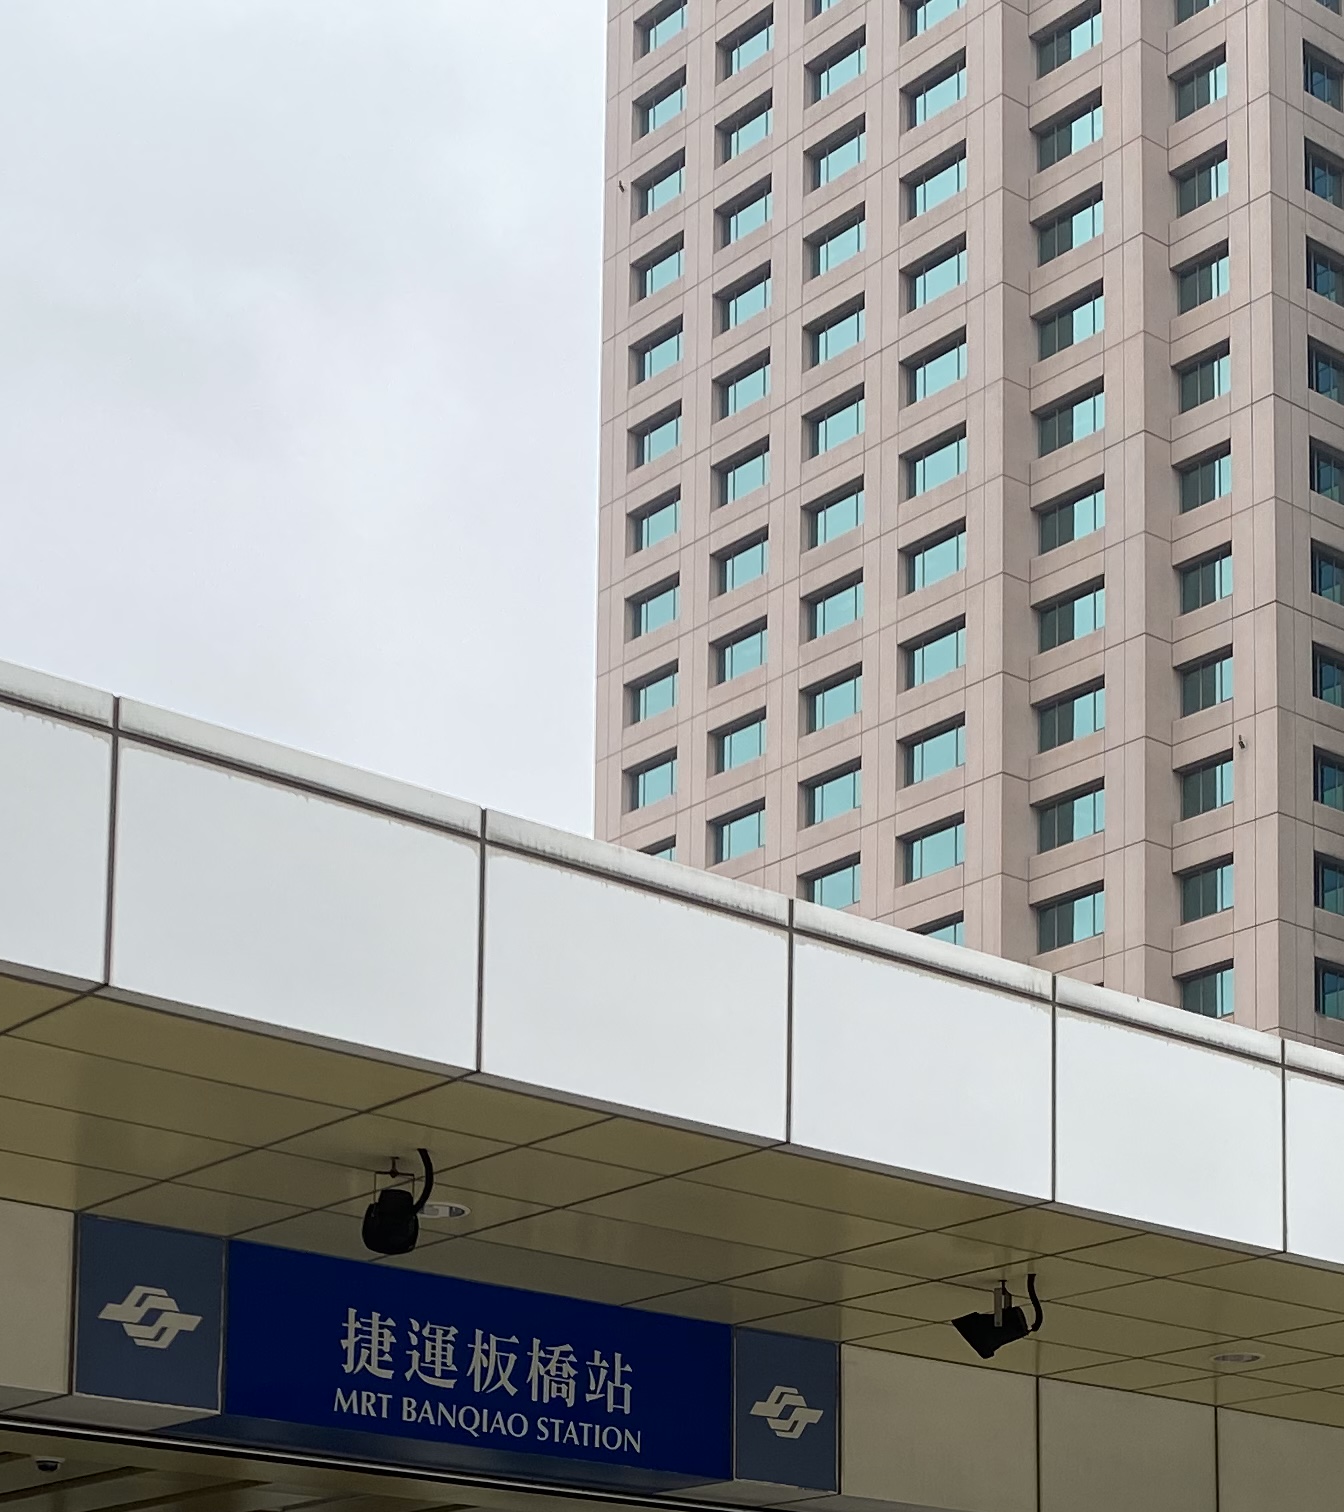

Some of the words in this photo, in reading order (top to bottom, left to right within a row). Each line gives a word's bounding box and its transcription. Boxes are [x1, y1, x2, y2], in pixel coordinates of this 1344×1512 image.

[340, 1307, 633, 1415] 捷運板橋站
[333, 1387, 393, 1419] MRT
[402, 1397, 529, 1438] BANQIAO
[536, 1416, 642, 1454] STATION
